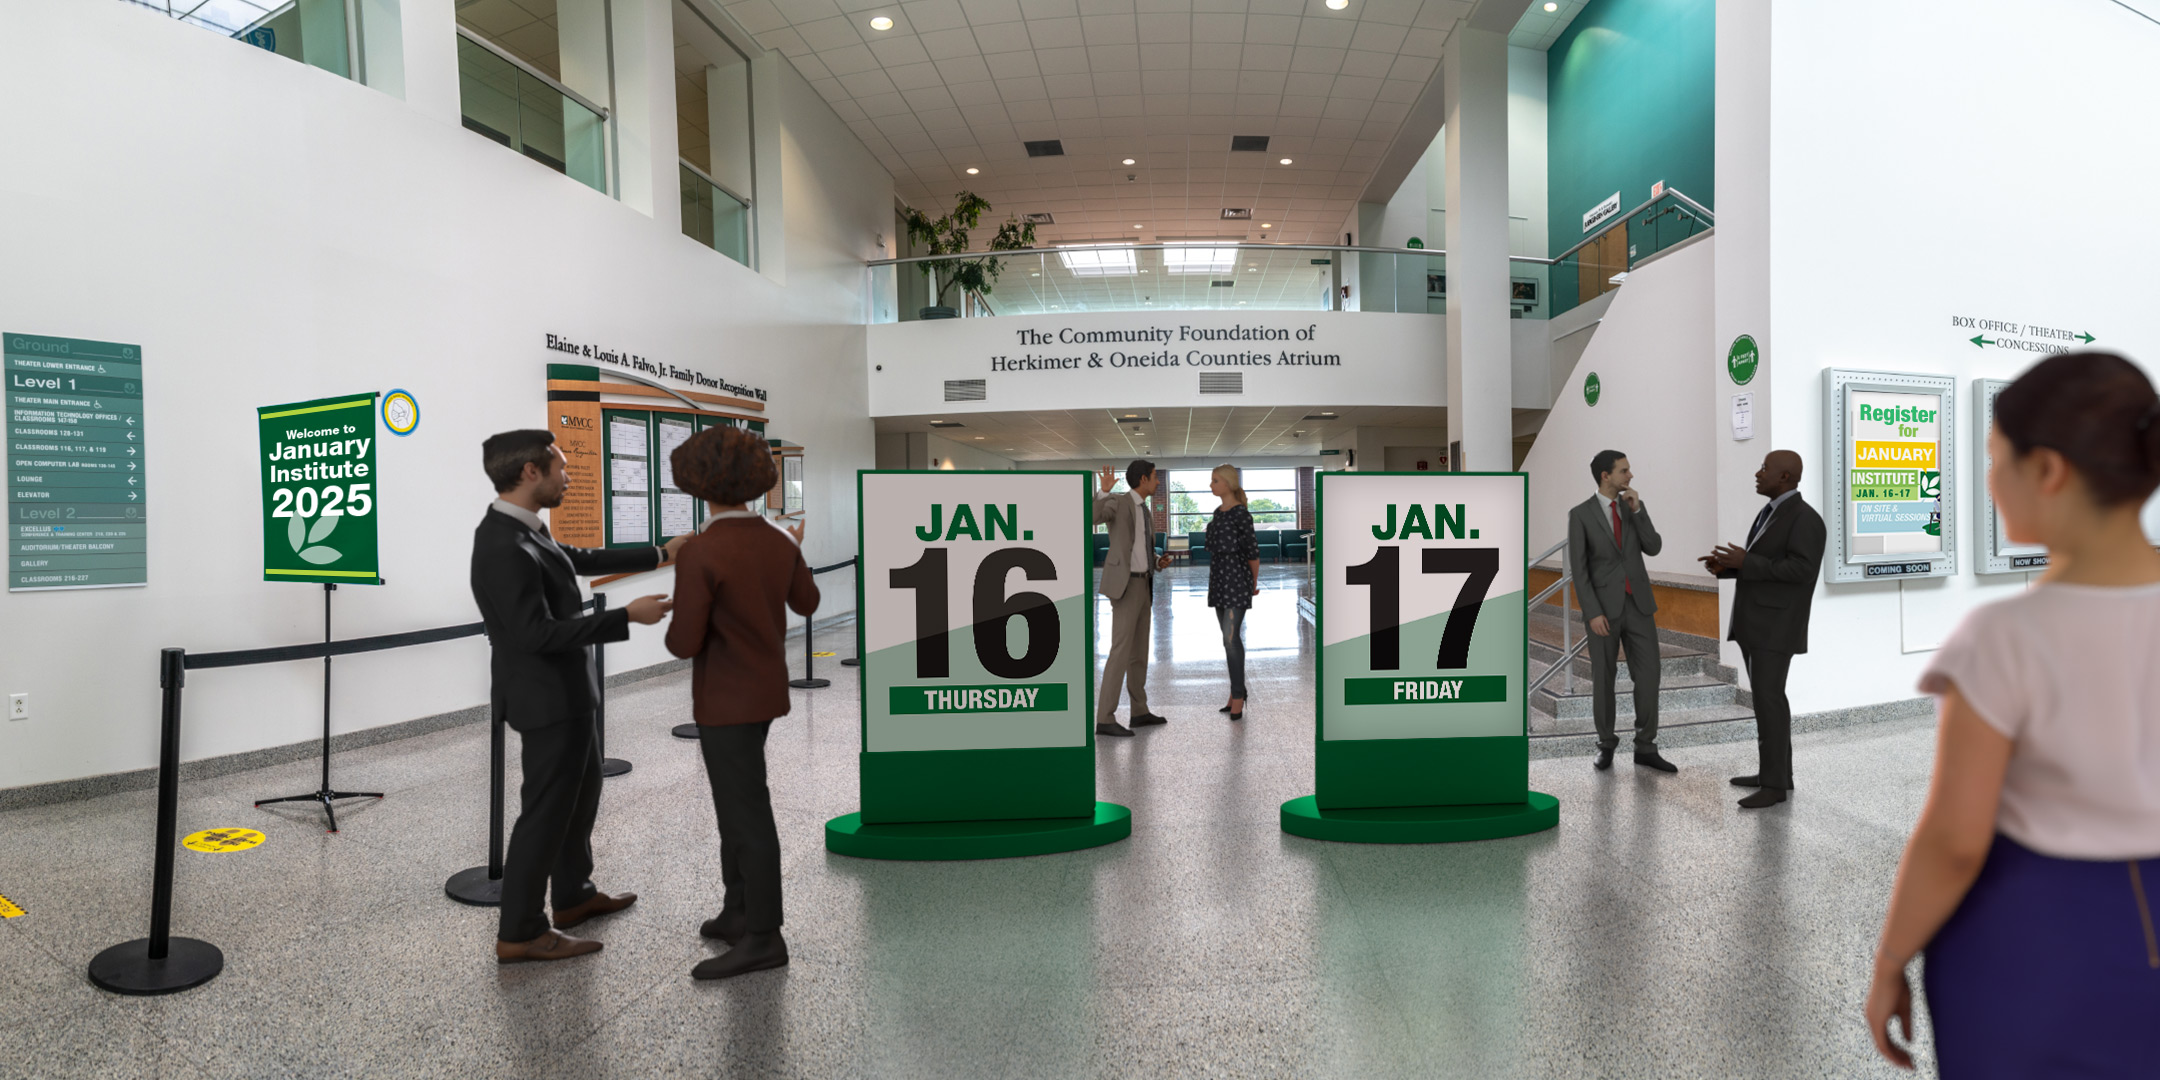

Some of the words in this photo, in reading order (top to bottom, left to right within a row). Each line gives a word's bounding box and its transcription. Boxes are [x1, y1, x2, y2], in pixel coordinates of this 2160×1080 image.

[1017, 329, 1052, 346] The
[1059, 326, 1173, 346] Community
[1180, 324, 1290, 341] Foundation
[1295, 324, 1316, 341] of
[1952, 316, 1976, 328] BOX
[1979, 319, 2018, 334] OFFICE
[2020, 324, 2026, 337] /
[2029, 326, 2074, 341] THEATER
[13, 338, 69, 353] Ground
[1996, 338, 2070, 356] CONCESSIONS
[65, 363, 95, 371] ENTRANCE
[546, 333, 580, 354] Elaine
[583, 344, 591, 357] &
[594, 345, 618, 364] Louis
[621, 353, 630, 367] A.
[632, 355, 657, 376] Falvo,
[658, 362, 667, 378] Jr.
[670, 365, 694, 386] Family
[696, 372, 718, 388] Donor
[720, 378, 754, 398] Recognition
[755, 388, 767, 401] Wall
[991, 353, 1081, 371] Herkimer
[1088, 352, 1103, 368] &
[1110, 351, 1180, 368] Oneida
[1186, 350, 1272, 366] Counties
[1276, 350, 1342, 366] Atrium
[14, 375, 60, 389] Level
[68, 379, 75, 390] 1
[569, 416, 593, 428] MVCC
[1860, 404, 1937, 425] Register
[286, 428, 340, 440] Welcome
[343, 425, 356, 434] to
[1898, 424, 1918, 437] for
[269, 438, 371, 461] January
[1858, 447, 1933, 461] JANUARY
[270, 461, 369, 482] Institute
[1852, 472, 1915, 485] INSTITUTE
[272, 483, 372, 518] 2025
[1856, 489, 1879, 498] JAN.
[1883, 489, 1910, 497] 16-17
[20, 507, 60, 518] Level
[66, 508, 75, 518] 2
[916, 504, 1033, 541] JAN.
[1372, 504, 1479, 540] JAN.
[1895, 513, 1931, 521] SESSIONS
[1868, 566, 1902, 574] COMING
[1906, 564, 1929, 572] SOON
[889, 547, 1060, 679] 16
[1346, 546, 1499, 671] 17
[924, 688, 1039, 710] THURSDAY
[1394, 680, 1463, 700] FRIDAY
